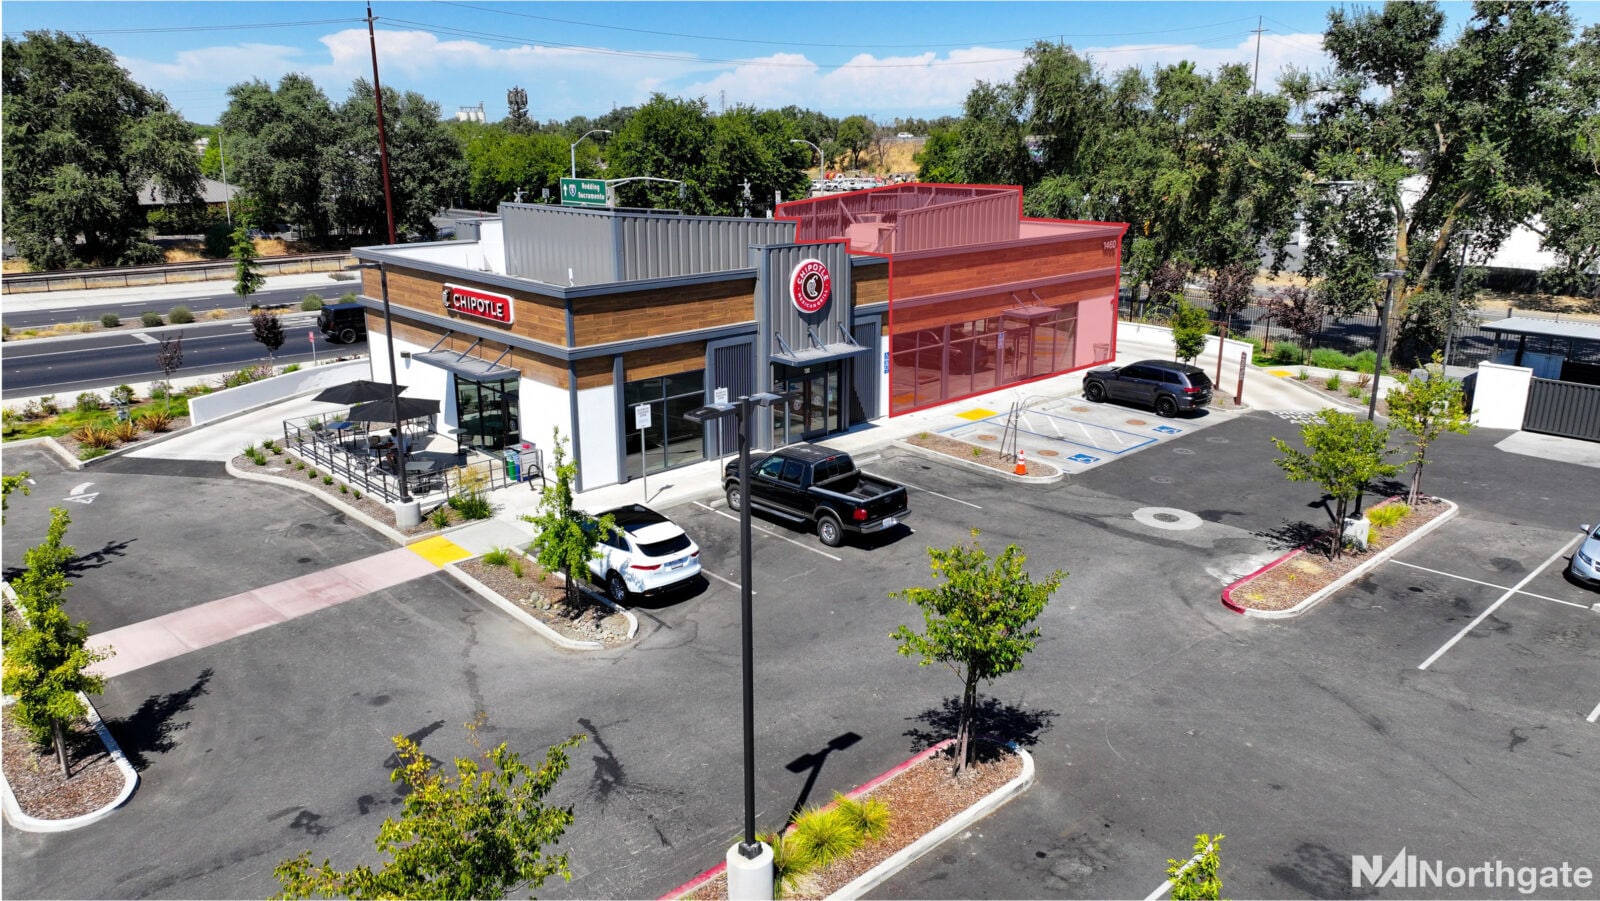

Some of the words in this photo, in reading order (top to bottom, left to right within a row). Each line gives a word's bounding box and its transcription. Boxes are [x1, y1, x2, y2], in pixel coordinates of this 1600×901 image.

[581, 182, 600, 193] Redding
[578, 192, 605, 200] Sacramento
[796, 264, 829, 285] CHIPOTLE
[453, 293, 504, 317] CHIPOTLE
